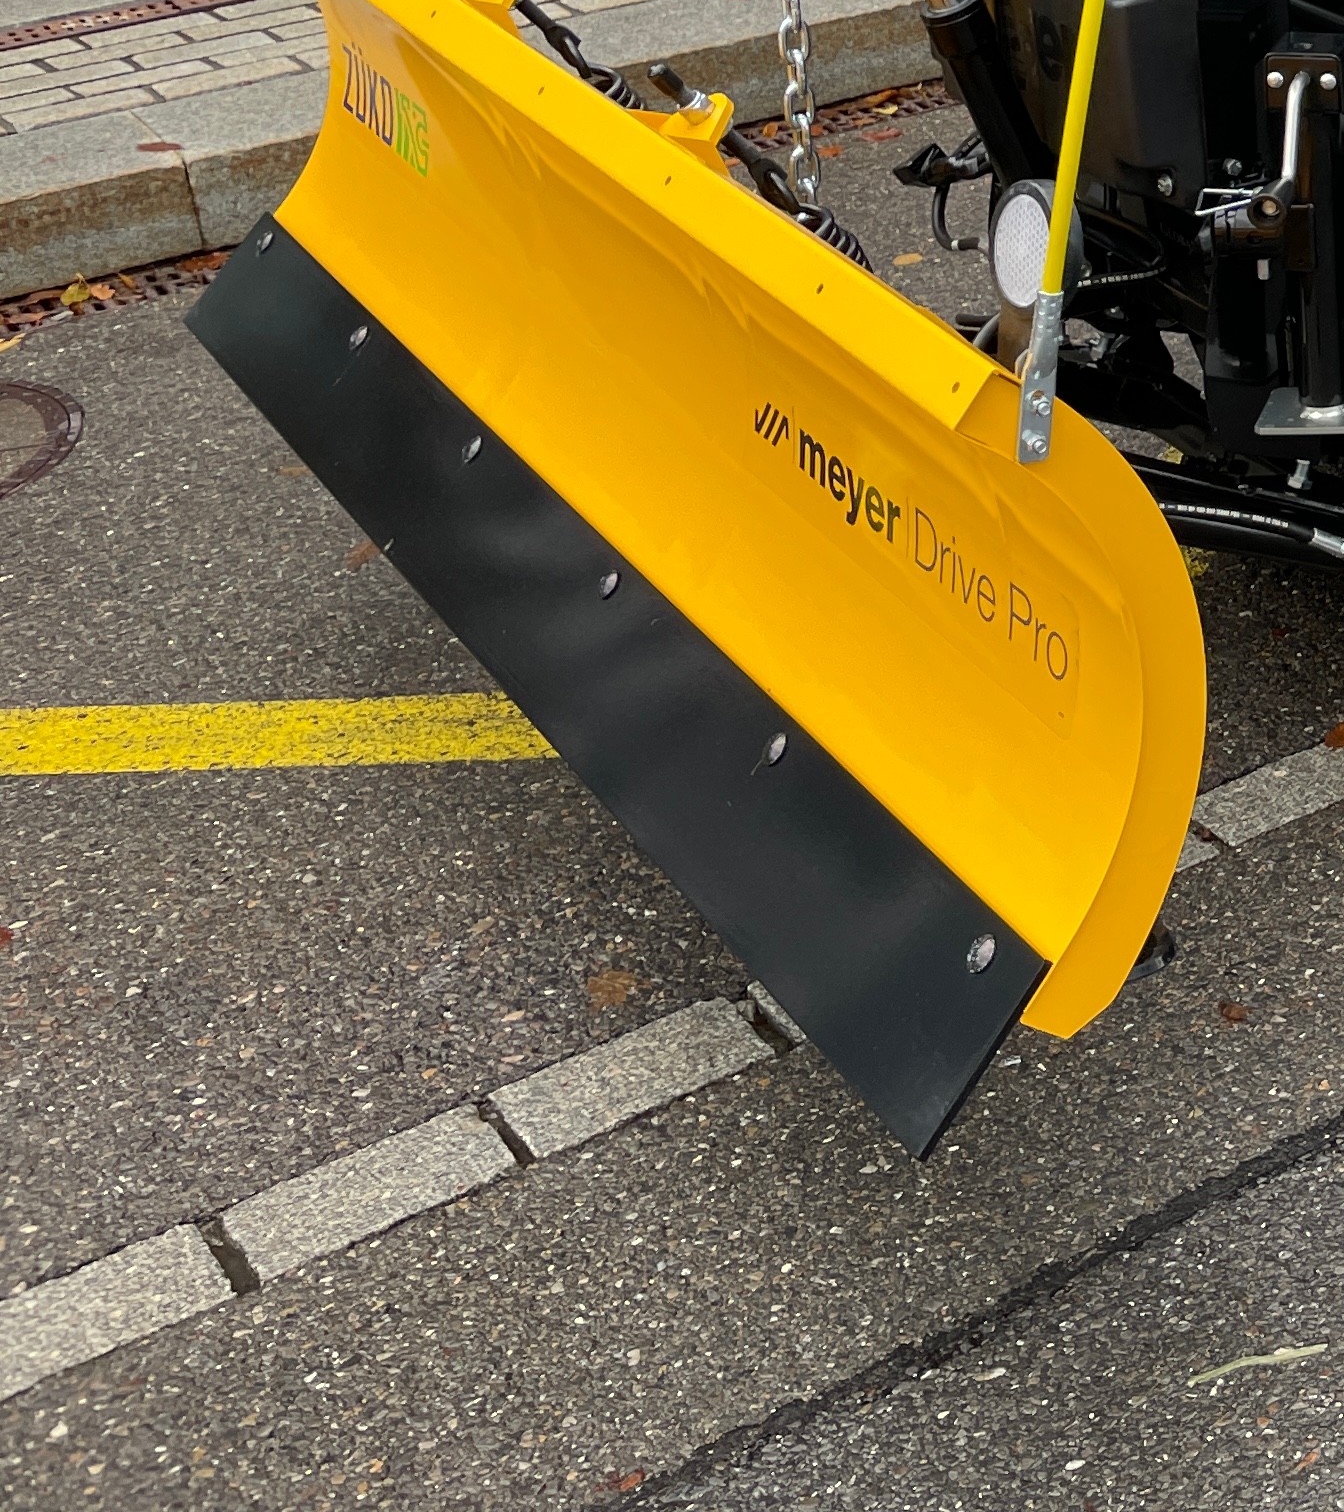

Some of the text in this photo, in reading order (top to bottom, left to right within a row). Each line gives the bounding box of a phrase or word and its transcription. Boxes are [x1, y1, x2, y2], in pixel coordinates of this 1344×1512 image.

[798, 427, 1069, 681] meyer Drive Pro
